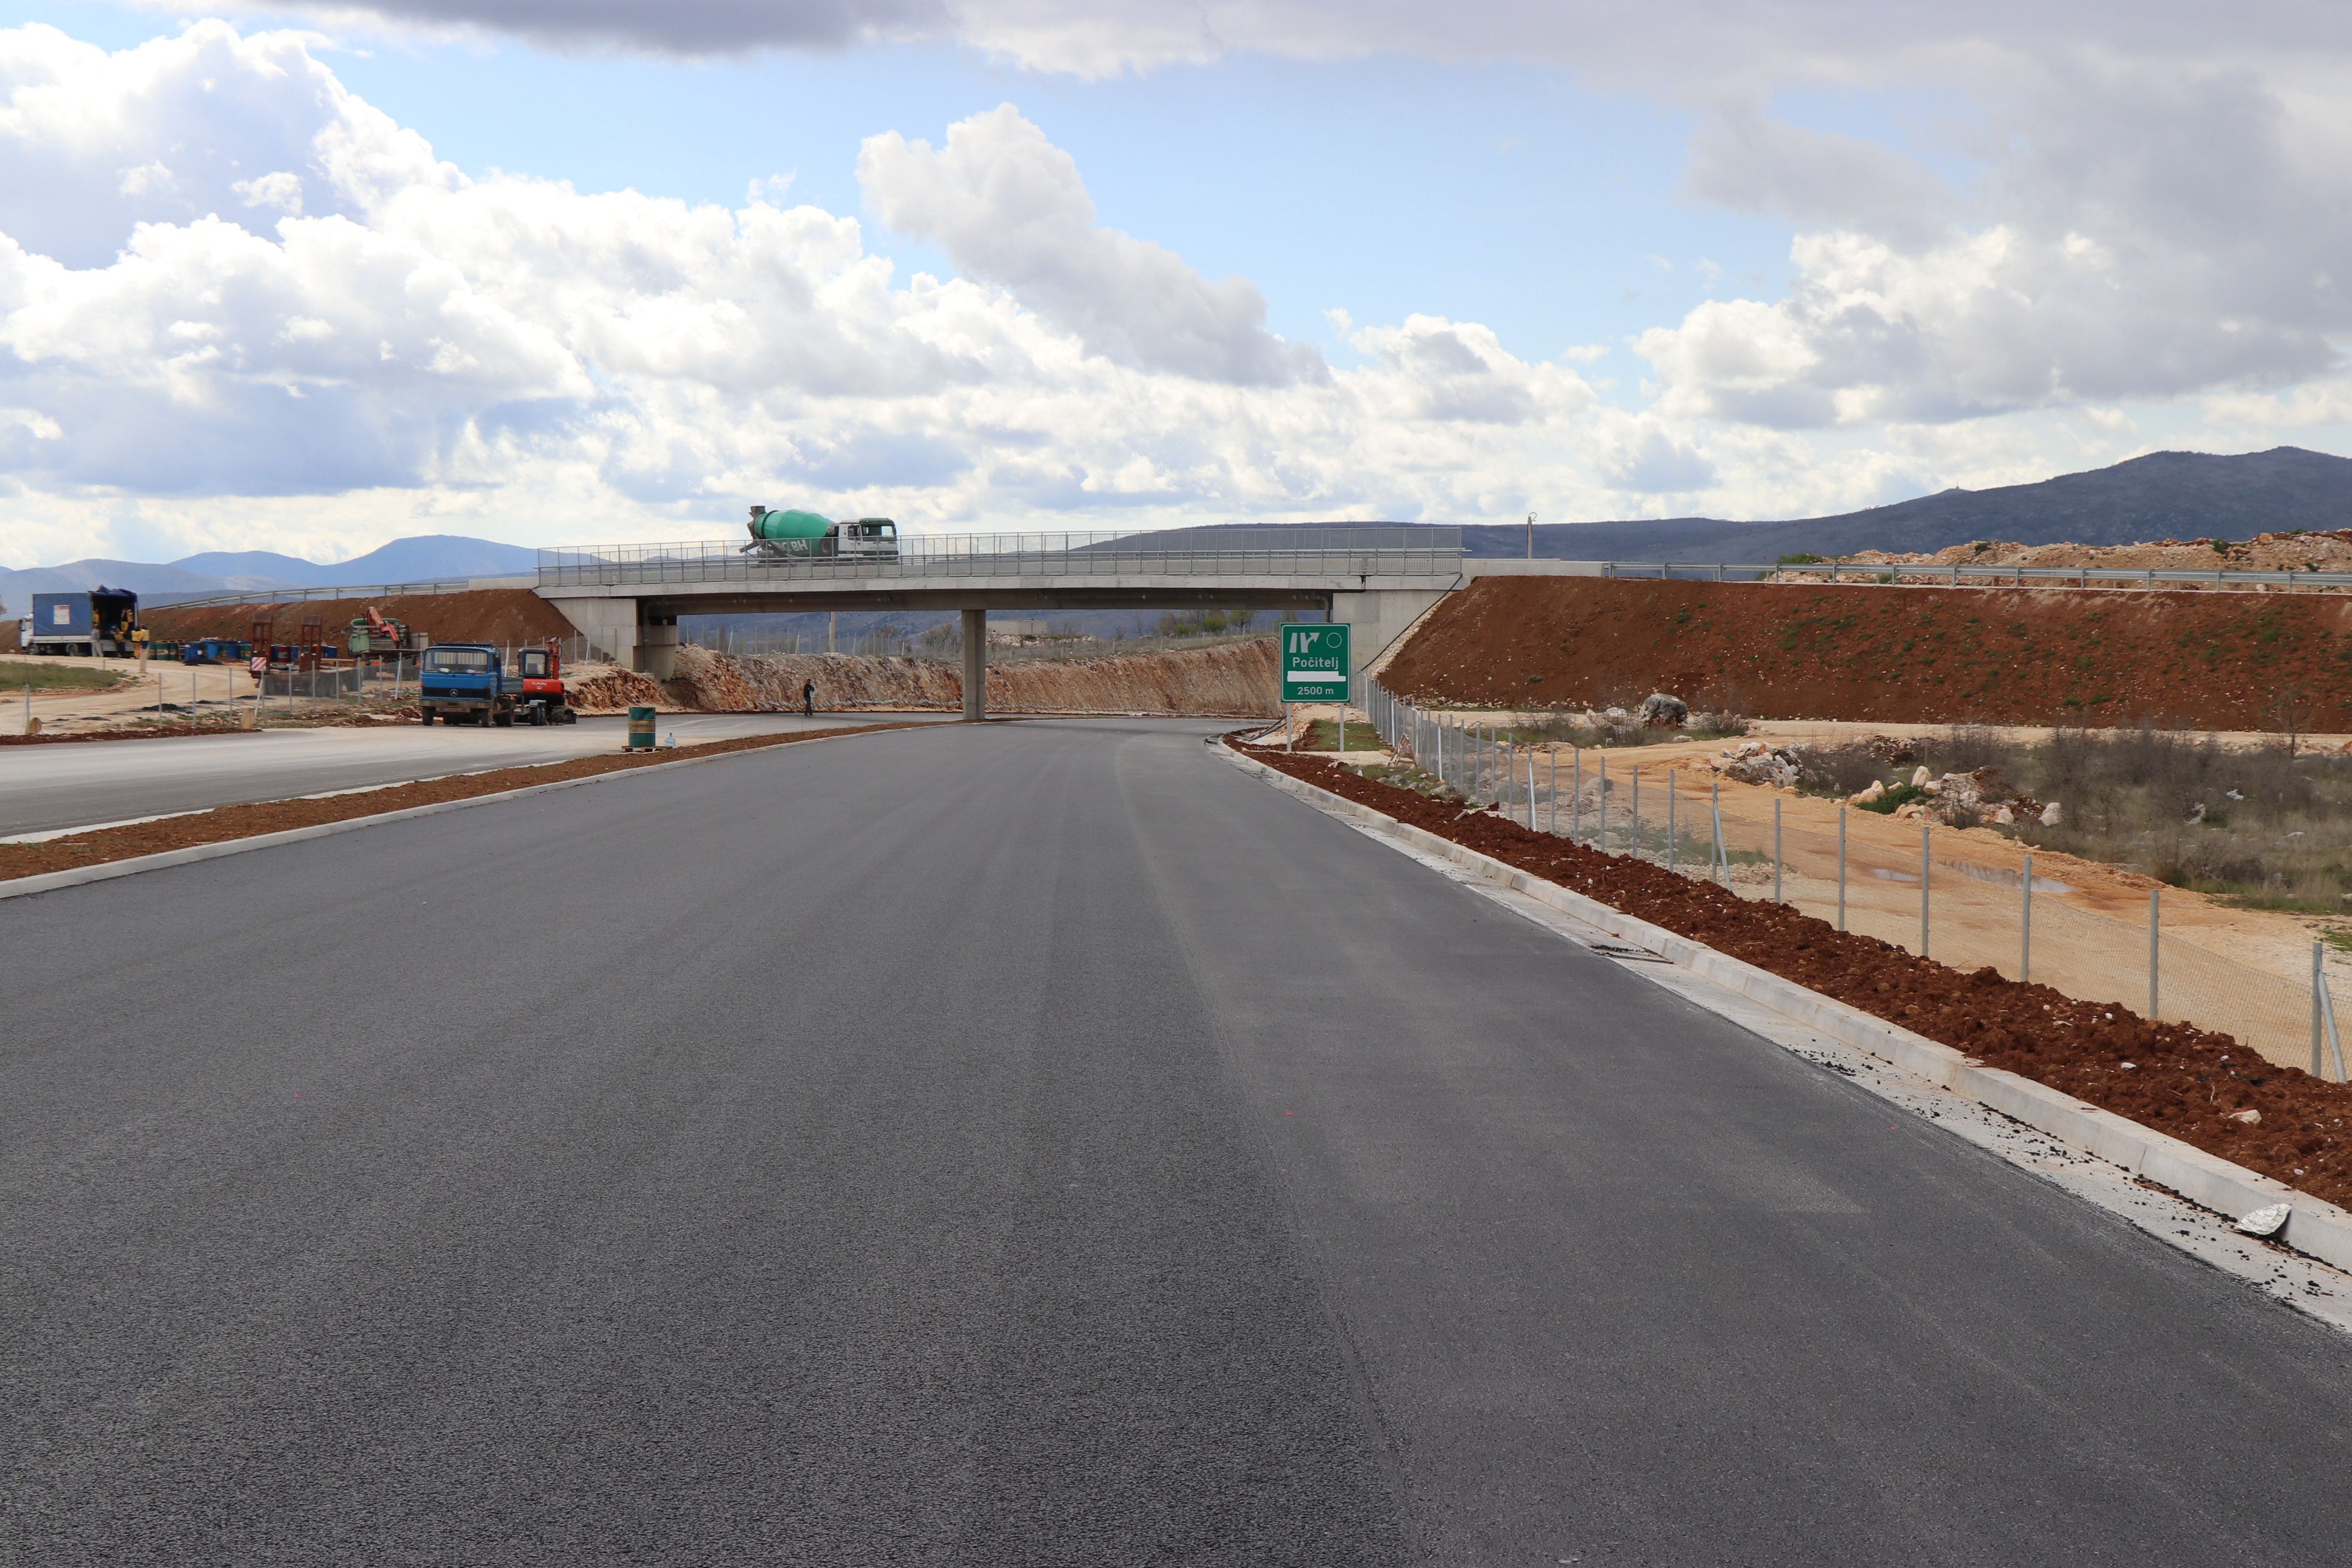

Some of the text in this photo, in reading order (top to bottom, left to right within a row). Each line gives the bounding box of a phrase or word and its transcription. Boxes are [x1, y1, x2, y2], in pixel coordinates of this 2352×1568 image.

[790, 539, 808, 551] BH
[1292, 656, 1338, 670] Počitelj
[1298, 687, 1322, 695] 2500
